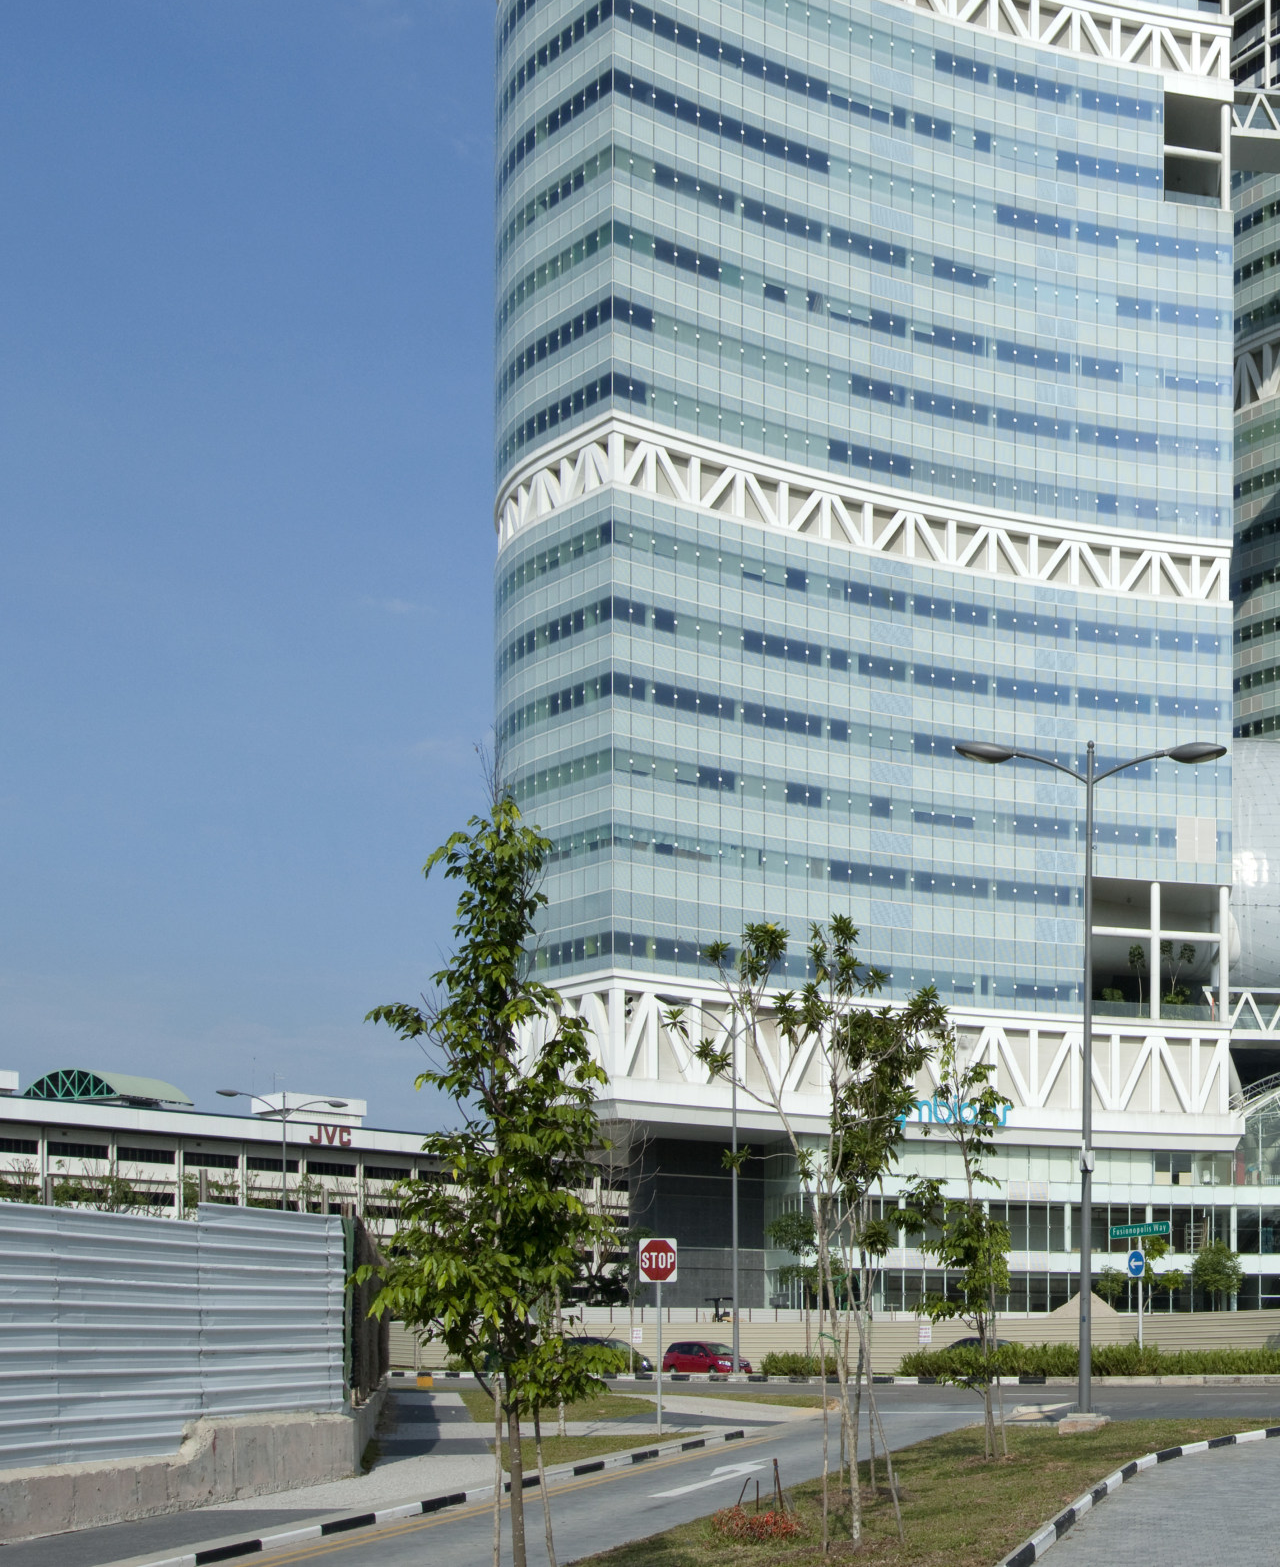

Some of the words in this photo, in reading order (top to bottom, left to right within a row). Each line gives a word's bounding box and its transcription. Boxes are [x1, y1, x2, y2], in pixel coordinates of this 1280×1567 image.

[309, 1125, 352, 1147] JVC
[1112, 1224, 1152, 1236] Fusionopolis
[1153, 1223, 1167, 1233] Way
[641, 1252, 675, 1269] STOP
